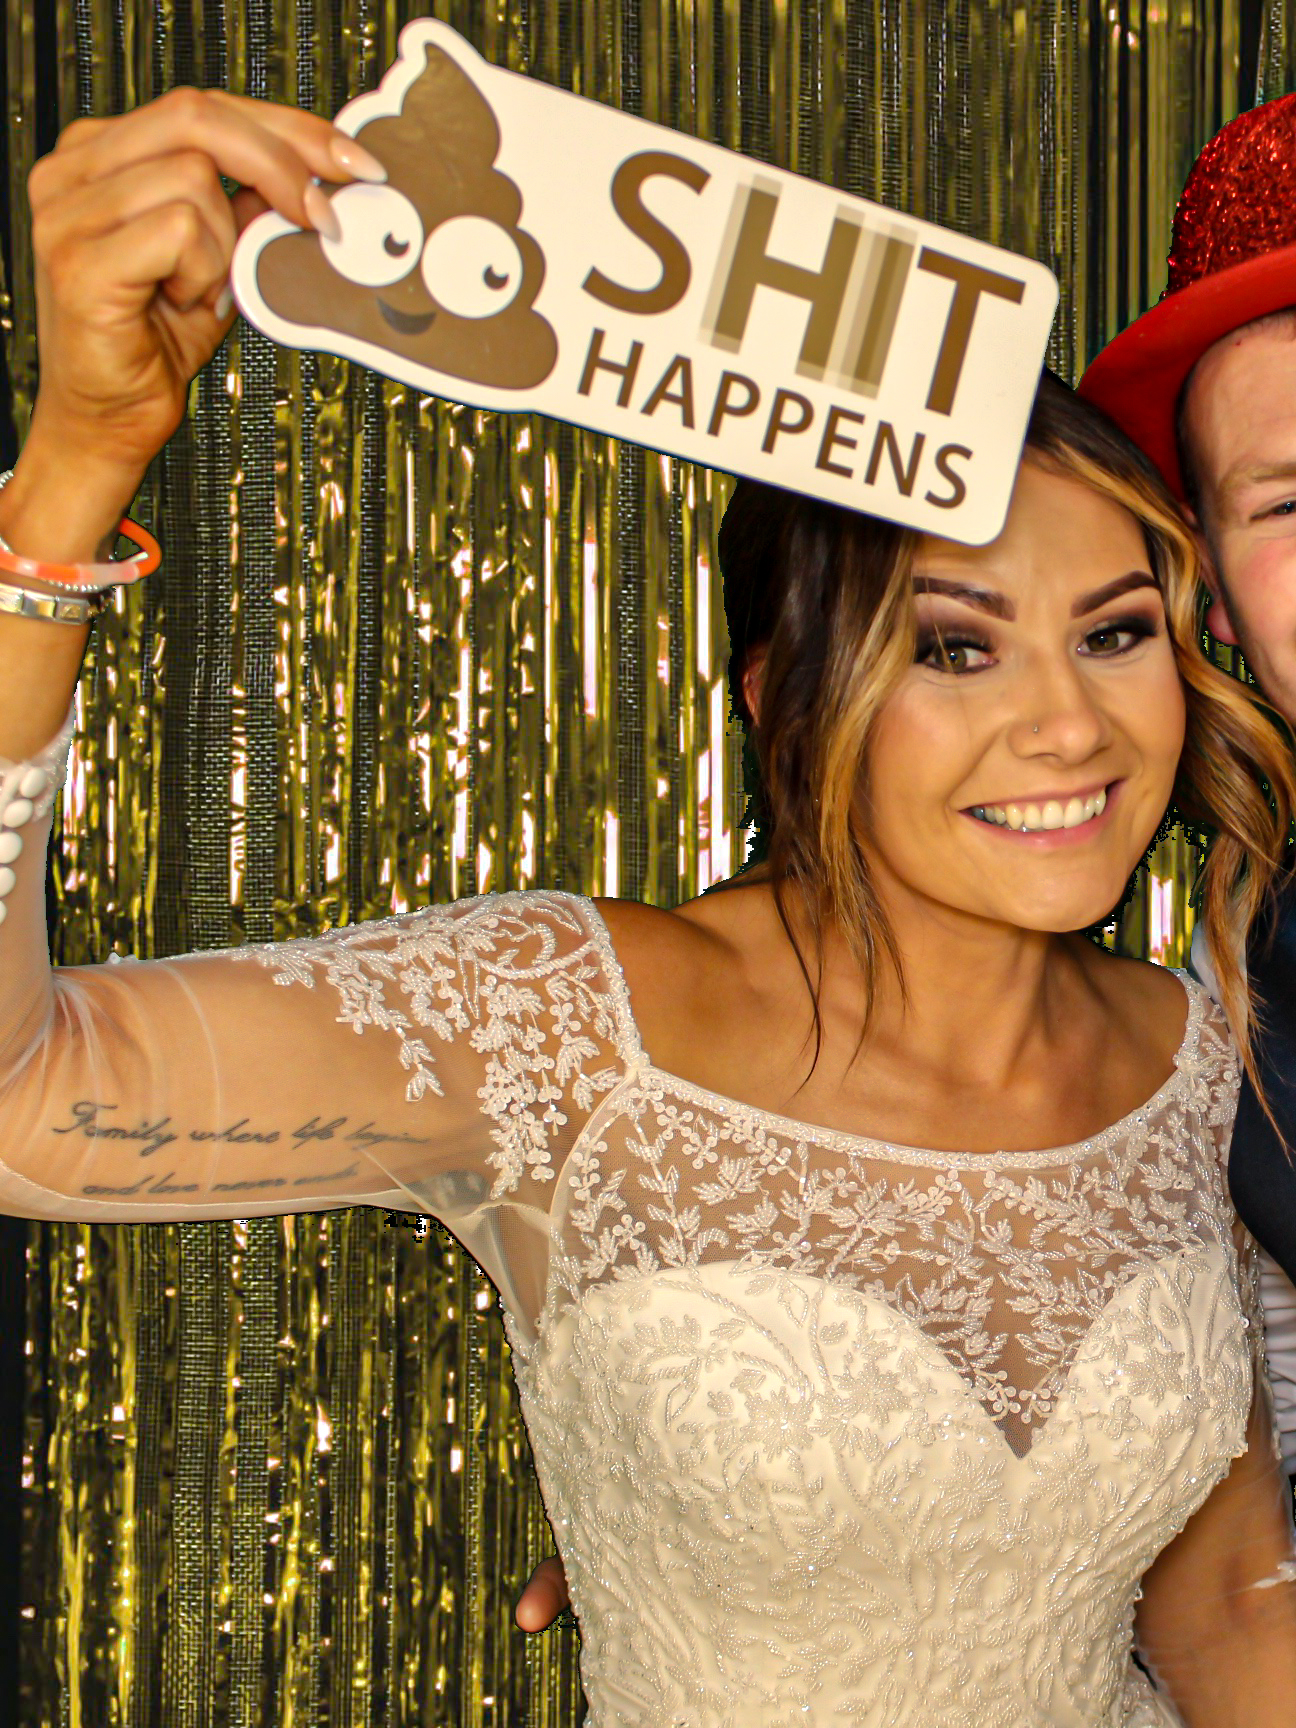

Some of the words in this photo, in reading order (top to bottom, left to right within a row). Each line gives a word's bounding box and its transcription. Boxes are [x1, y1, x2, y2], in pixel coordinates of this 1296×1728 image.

[581, 148, 1027, 418] SHIT
[576, 327, 974, 510] HAPPENS
[52, 1101, 178, 1157] Family
[189, 1118, 280, 1144] where
